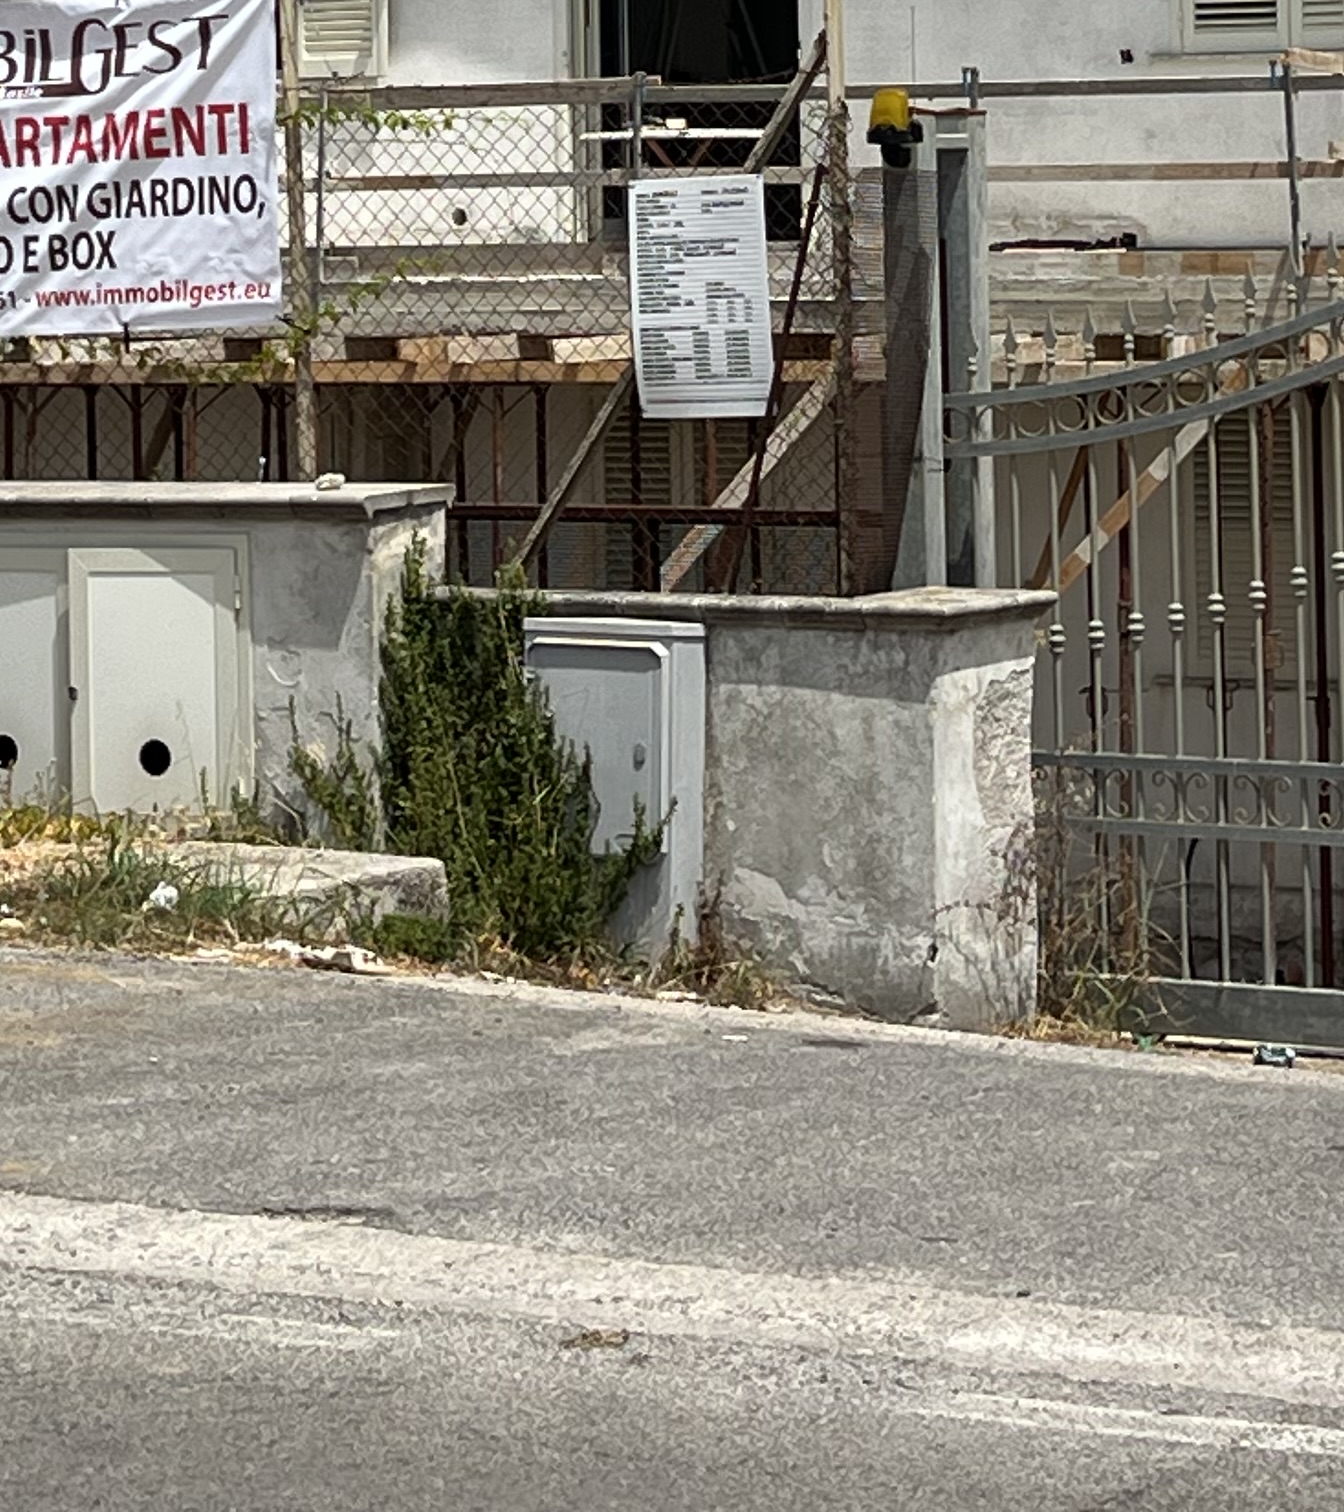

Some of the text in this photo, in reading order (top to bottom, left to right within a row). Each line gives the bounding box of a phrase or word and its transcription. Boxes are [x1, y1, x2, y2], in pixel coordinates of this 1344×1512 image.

[7, 184, 78, 225] CON
[86, 174, 266, 220] GIARDINO,
[22, 235, 39, 274] E
[48, 230, 117, 271] BOX
[35, 279, 272, 309] www.immobilgest.eu
